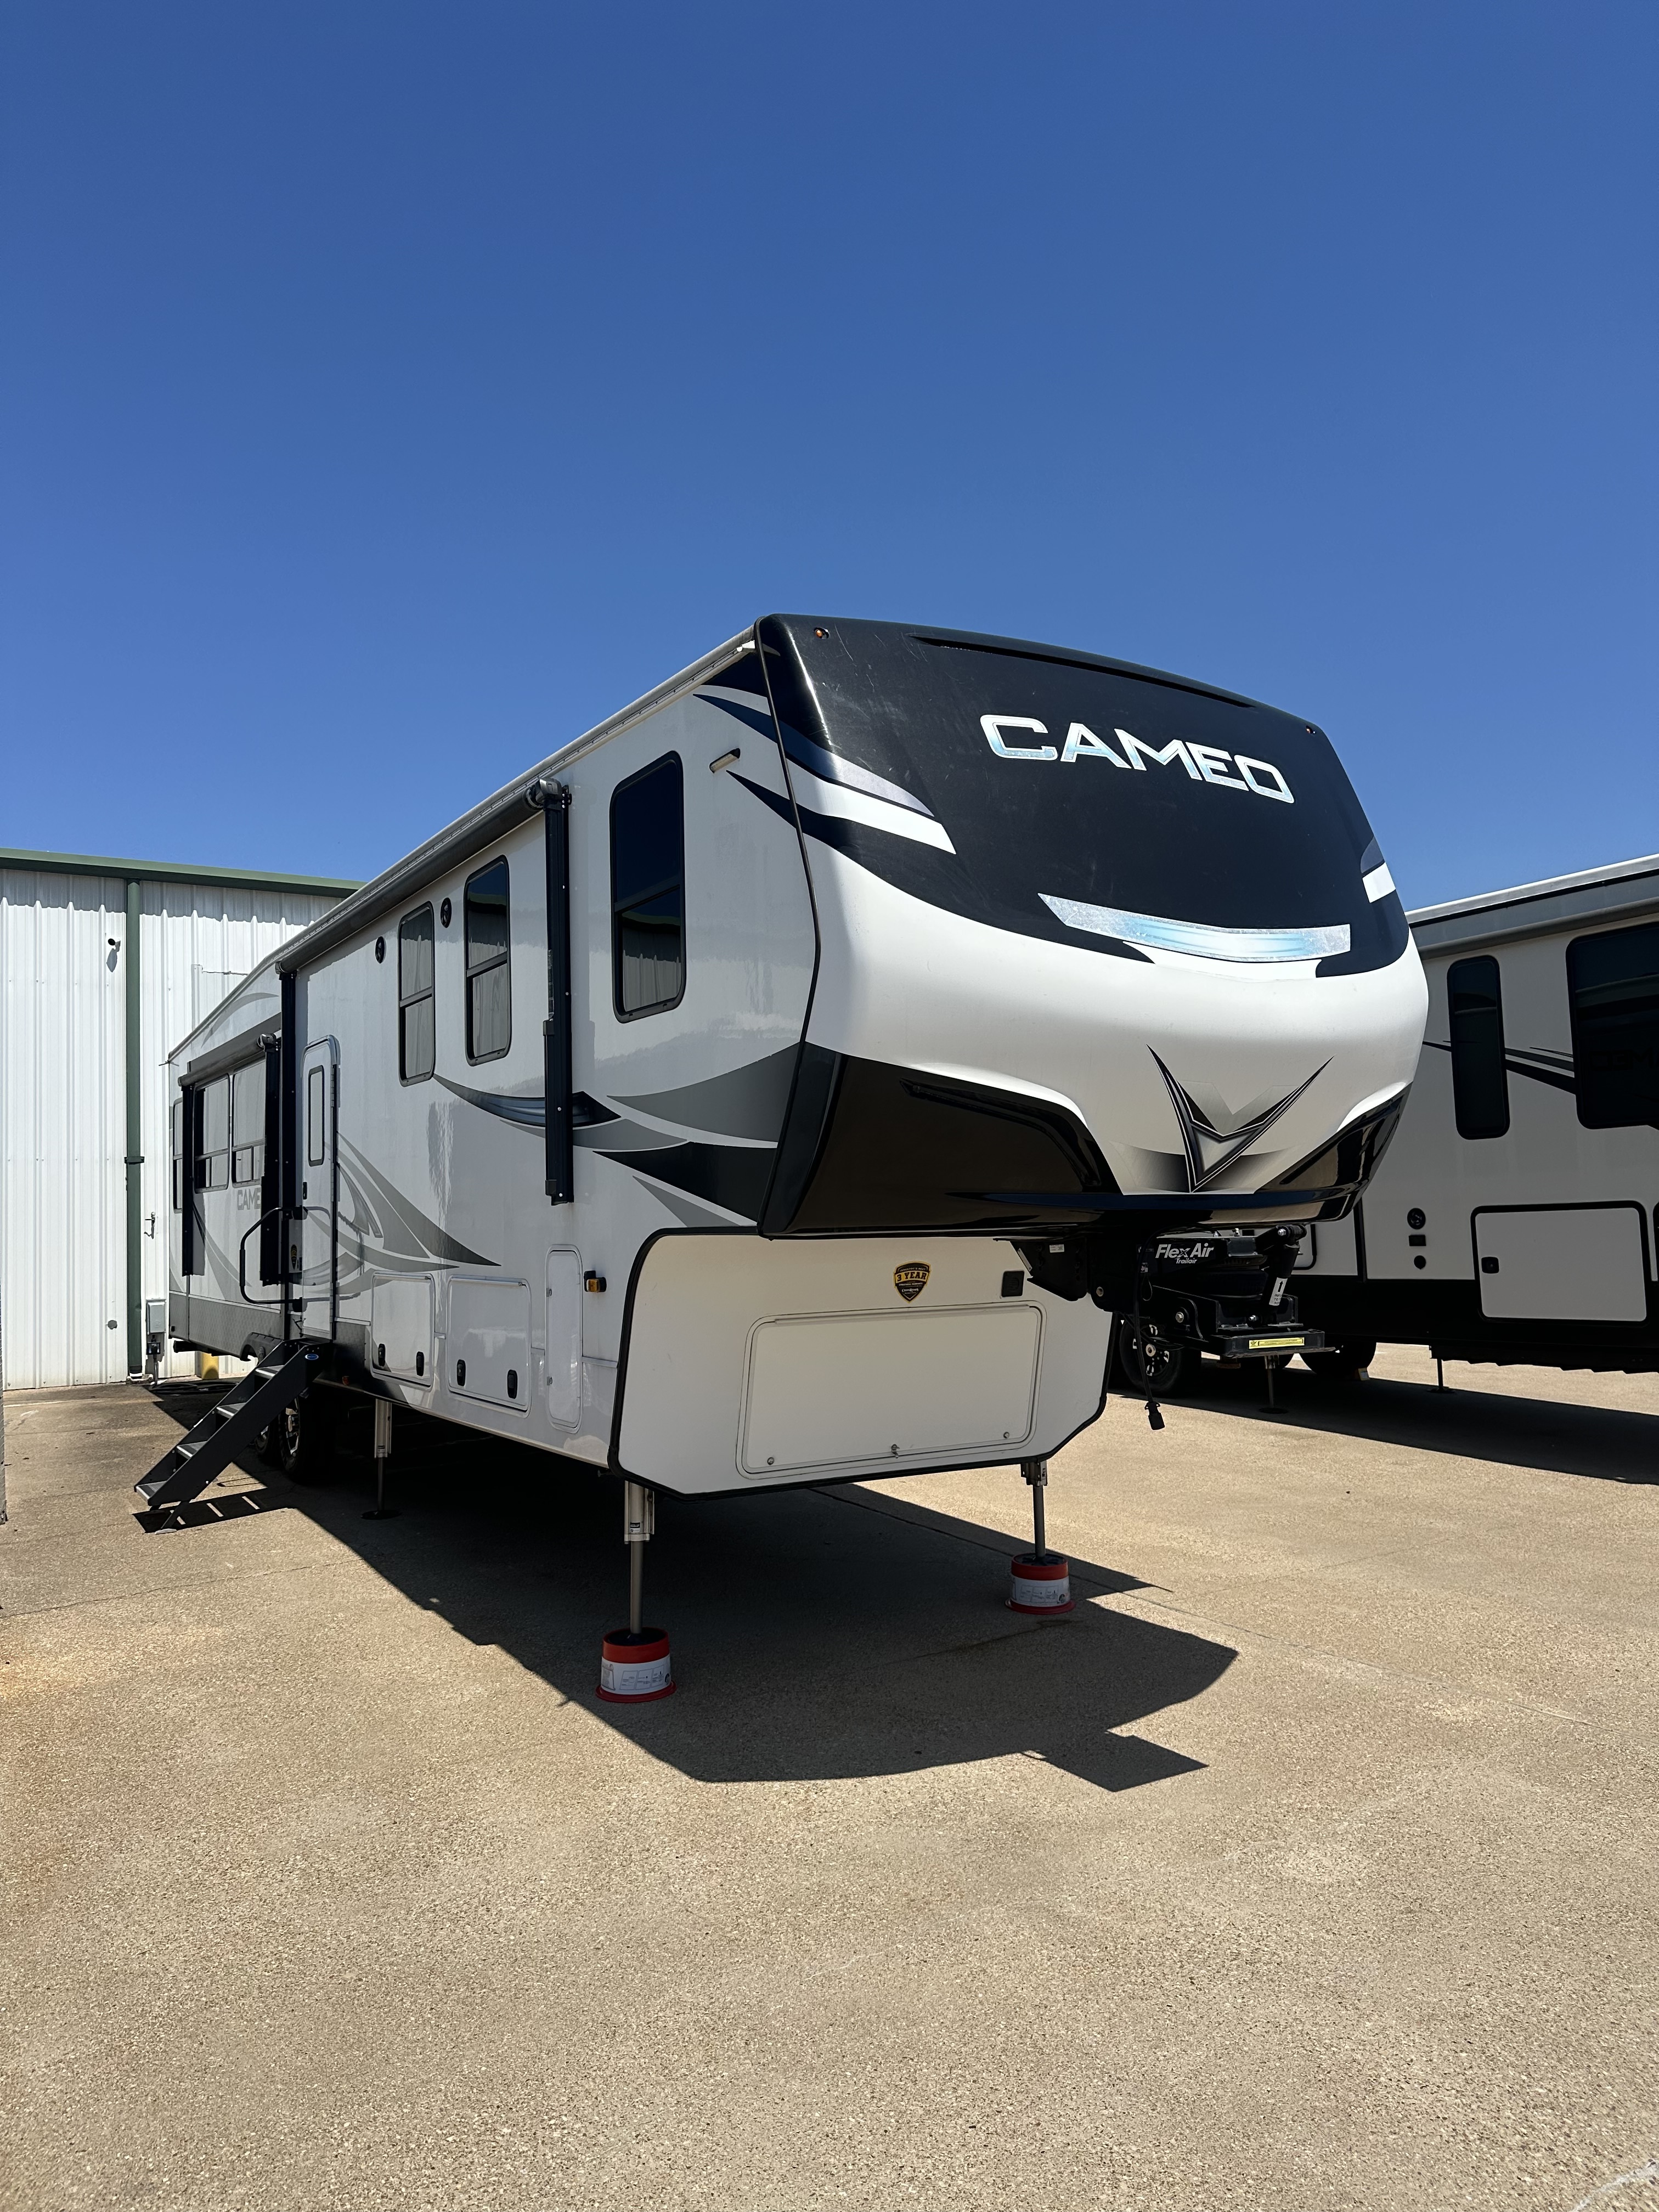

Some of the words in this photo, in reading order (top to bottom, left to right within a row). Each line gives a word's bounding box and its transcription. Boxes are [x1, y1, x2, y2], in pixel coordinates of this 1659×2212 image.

[980, 714, 1295, 804] CAMEO
[238, 1188, 261, 1210] CAME
[1155, 1244, 1190, 1259] Flex
[1190, 1243, 1215, 1257] Air
[904, 1271, 927, 1280] YEAR
